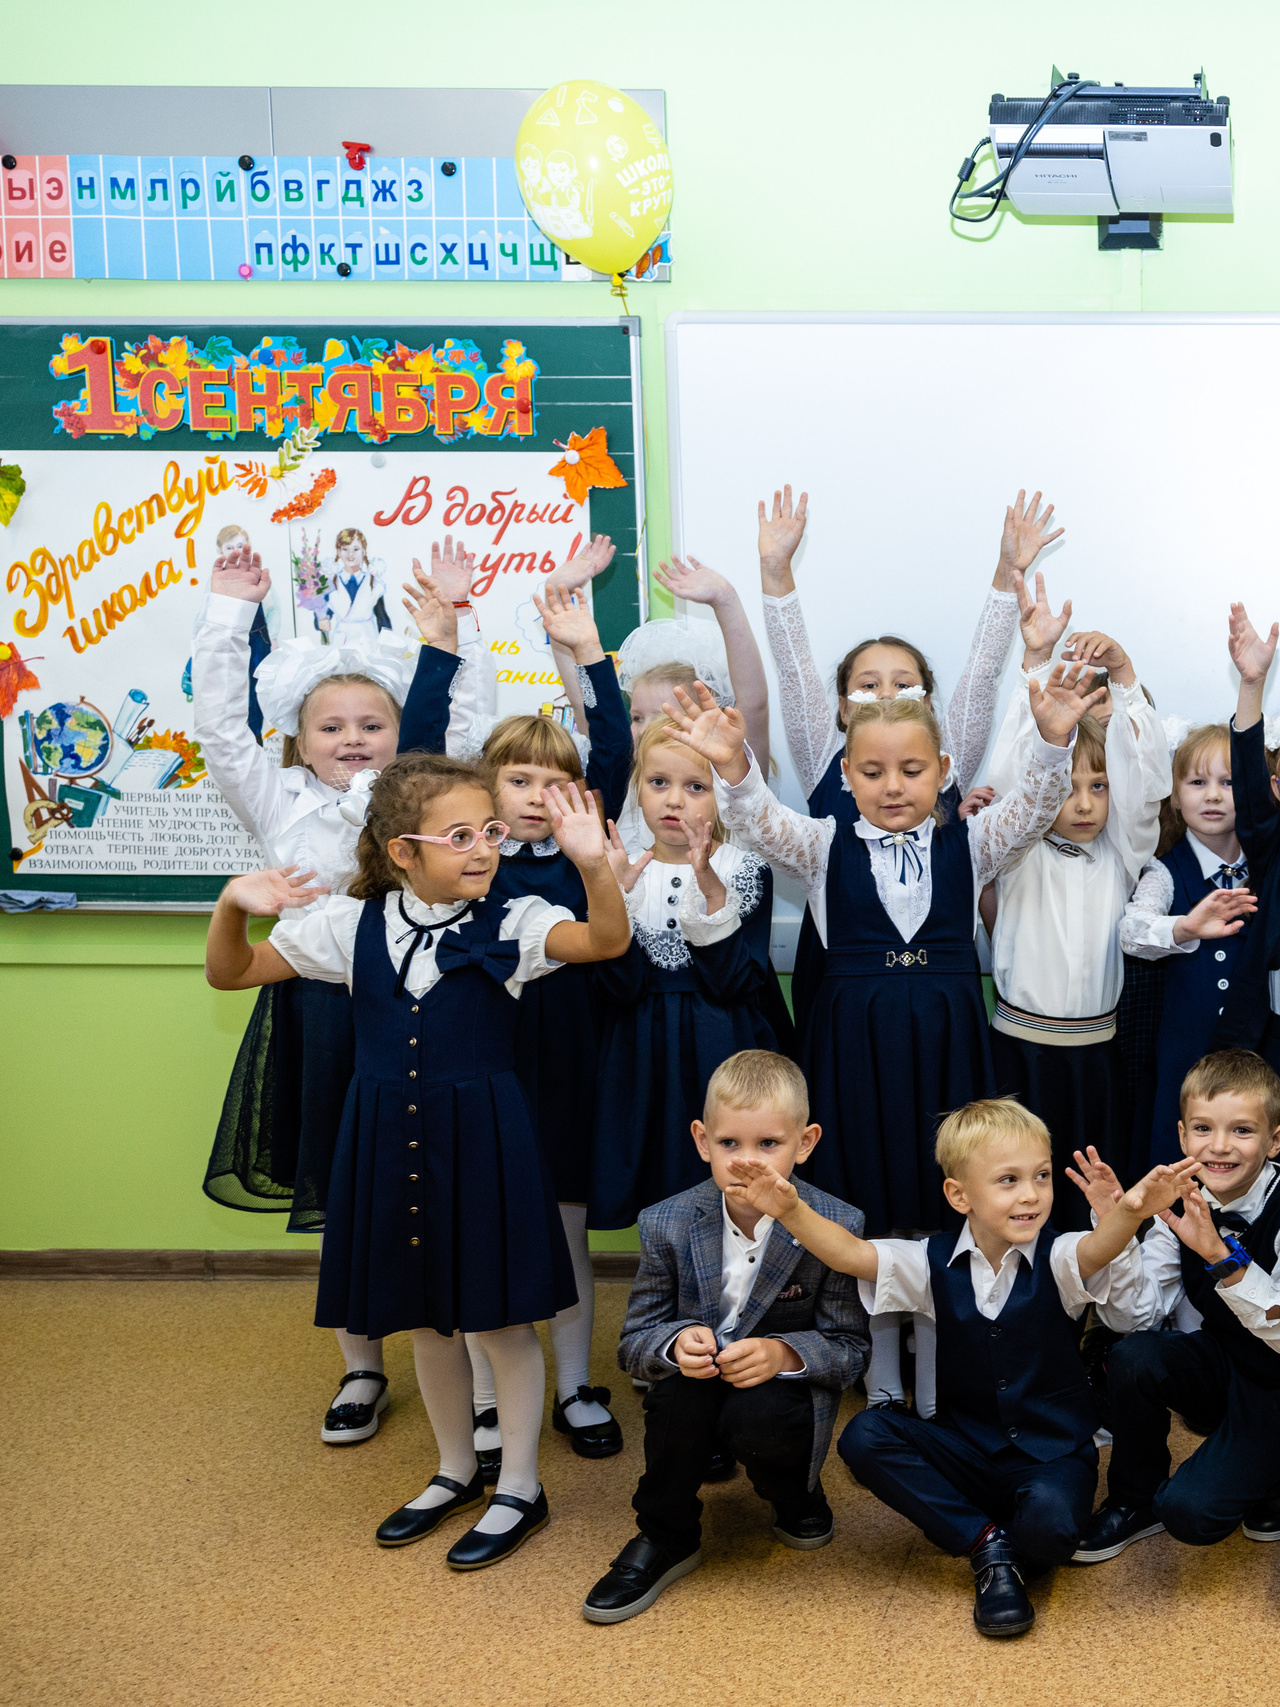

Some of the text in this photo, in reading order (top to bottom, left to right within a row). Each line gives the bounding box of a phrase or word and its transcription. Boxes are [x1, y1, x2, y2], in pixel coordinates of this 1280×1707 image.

[67, 337, 535, 437] 1 СЕНТЯБРЯ
[373, 475, 576, 545] В добрый
[6, 454, 236, 638] Здравствуй
[121, 791, 171, 803] ПЕРВЫЙ
[175, 792, 202, 803] МИР
[114, 805, 169, 817] УЧИТЕЛЬ
[173, 807, 192, 817] УМ
[97, 818, 145, 829] ЧТЕНИЕ
[148, 819, 217, 831] МУДРОСТЬ
[49, 830, 106, 841] ПОМОЩЬ
[107, 831, 144, 842] ЧЕСТЬ
[150, 832, 203, 844] ЛЮБОВЬ
[206, 834, 240, 846] ДОЛГ
[45, 844, 94, 855] ОТВАГА
[107, 843, 169, 856] ТЕРПЕНИЕ
[174, 846, 231, 857] ДОБРОТА
[28, 859, 137, 871] ВЗАИМОПОМОЩЬ
[143, 859, 208, 871] РОДИТЕЛИ
